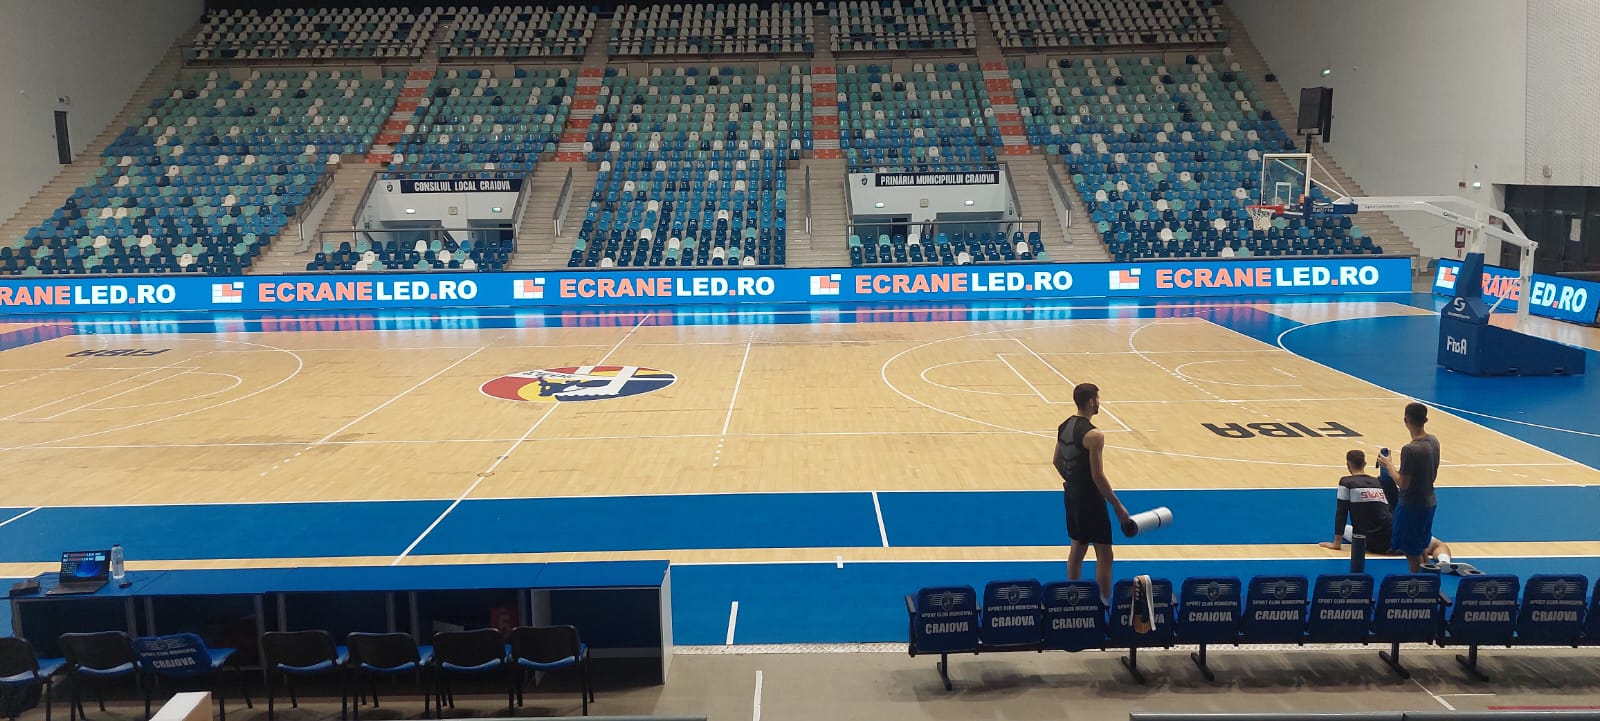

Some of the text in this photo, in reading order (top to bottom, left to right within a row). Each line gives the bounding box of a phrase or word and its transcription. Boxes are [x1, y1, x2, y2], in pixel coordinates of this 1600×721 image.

[916, 173, 963, 185] MUNICIPIULUI
[965, 173, 995, 184] CRAIOVA
[414, 181, 511, 191] CONSILIUL LOCAL CRAIOVA
[1200, 421, 1363, 438] FIBA
[1188, 611, 1232, 622] CRAIOVA
[1255, 609, 1299, 621] CRAIOVA
[1320, 609, 1364, 620] CRAIOVA
[1387, 609, 1431, 619] CRAIOVA
[1464, 611, 1510, 622] CRAIOVA
[1531, 610, 1577, 622] CRAIOVA
[925, 621, 968, 634] CRAIOVA
[991, 615, 1035, 628] CRAIOVA
[1052, 617, 1095, 630] CRAIOVA
[152, 656, 196, 669] CRAIOVA
